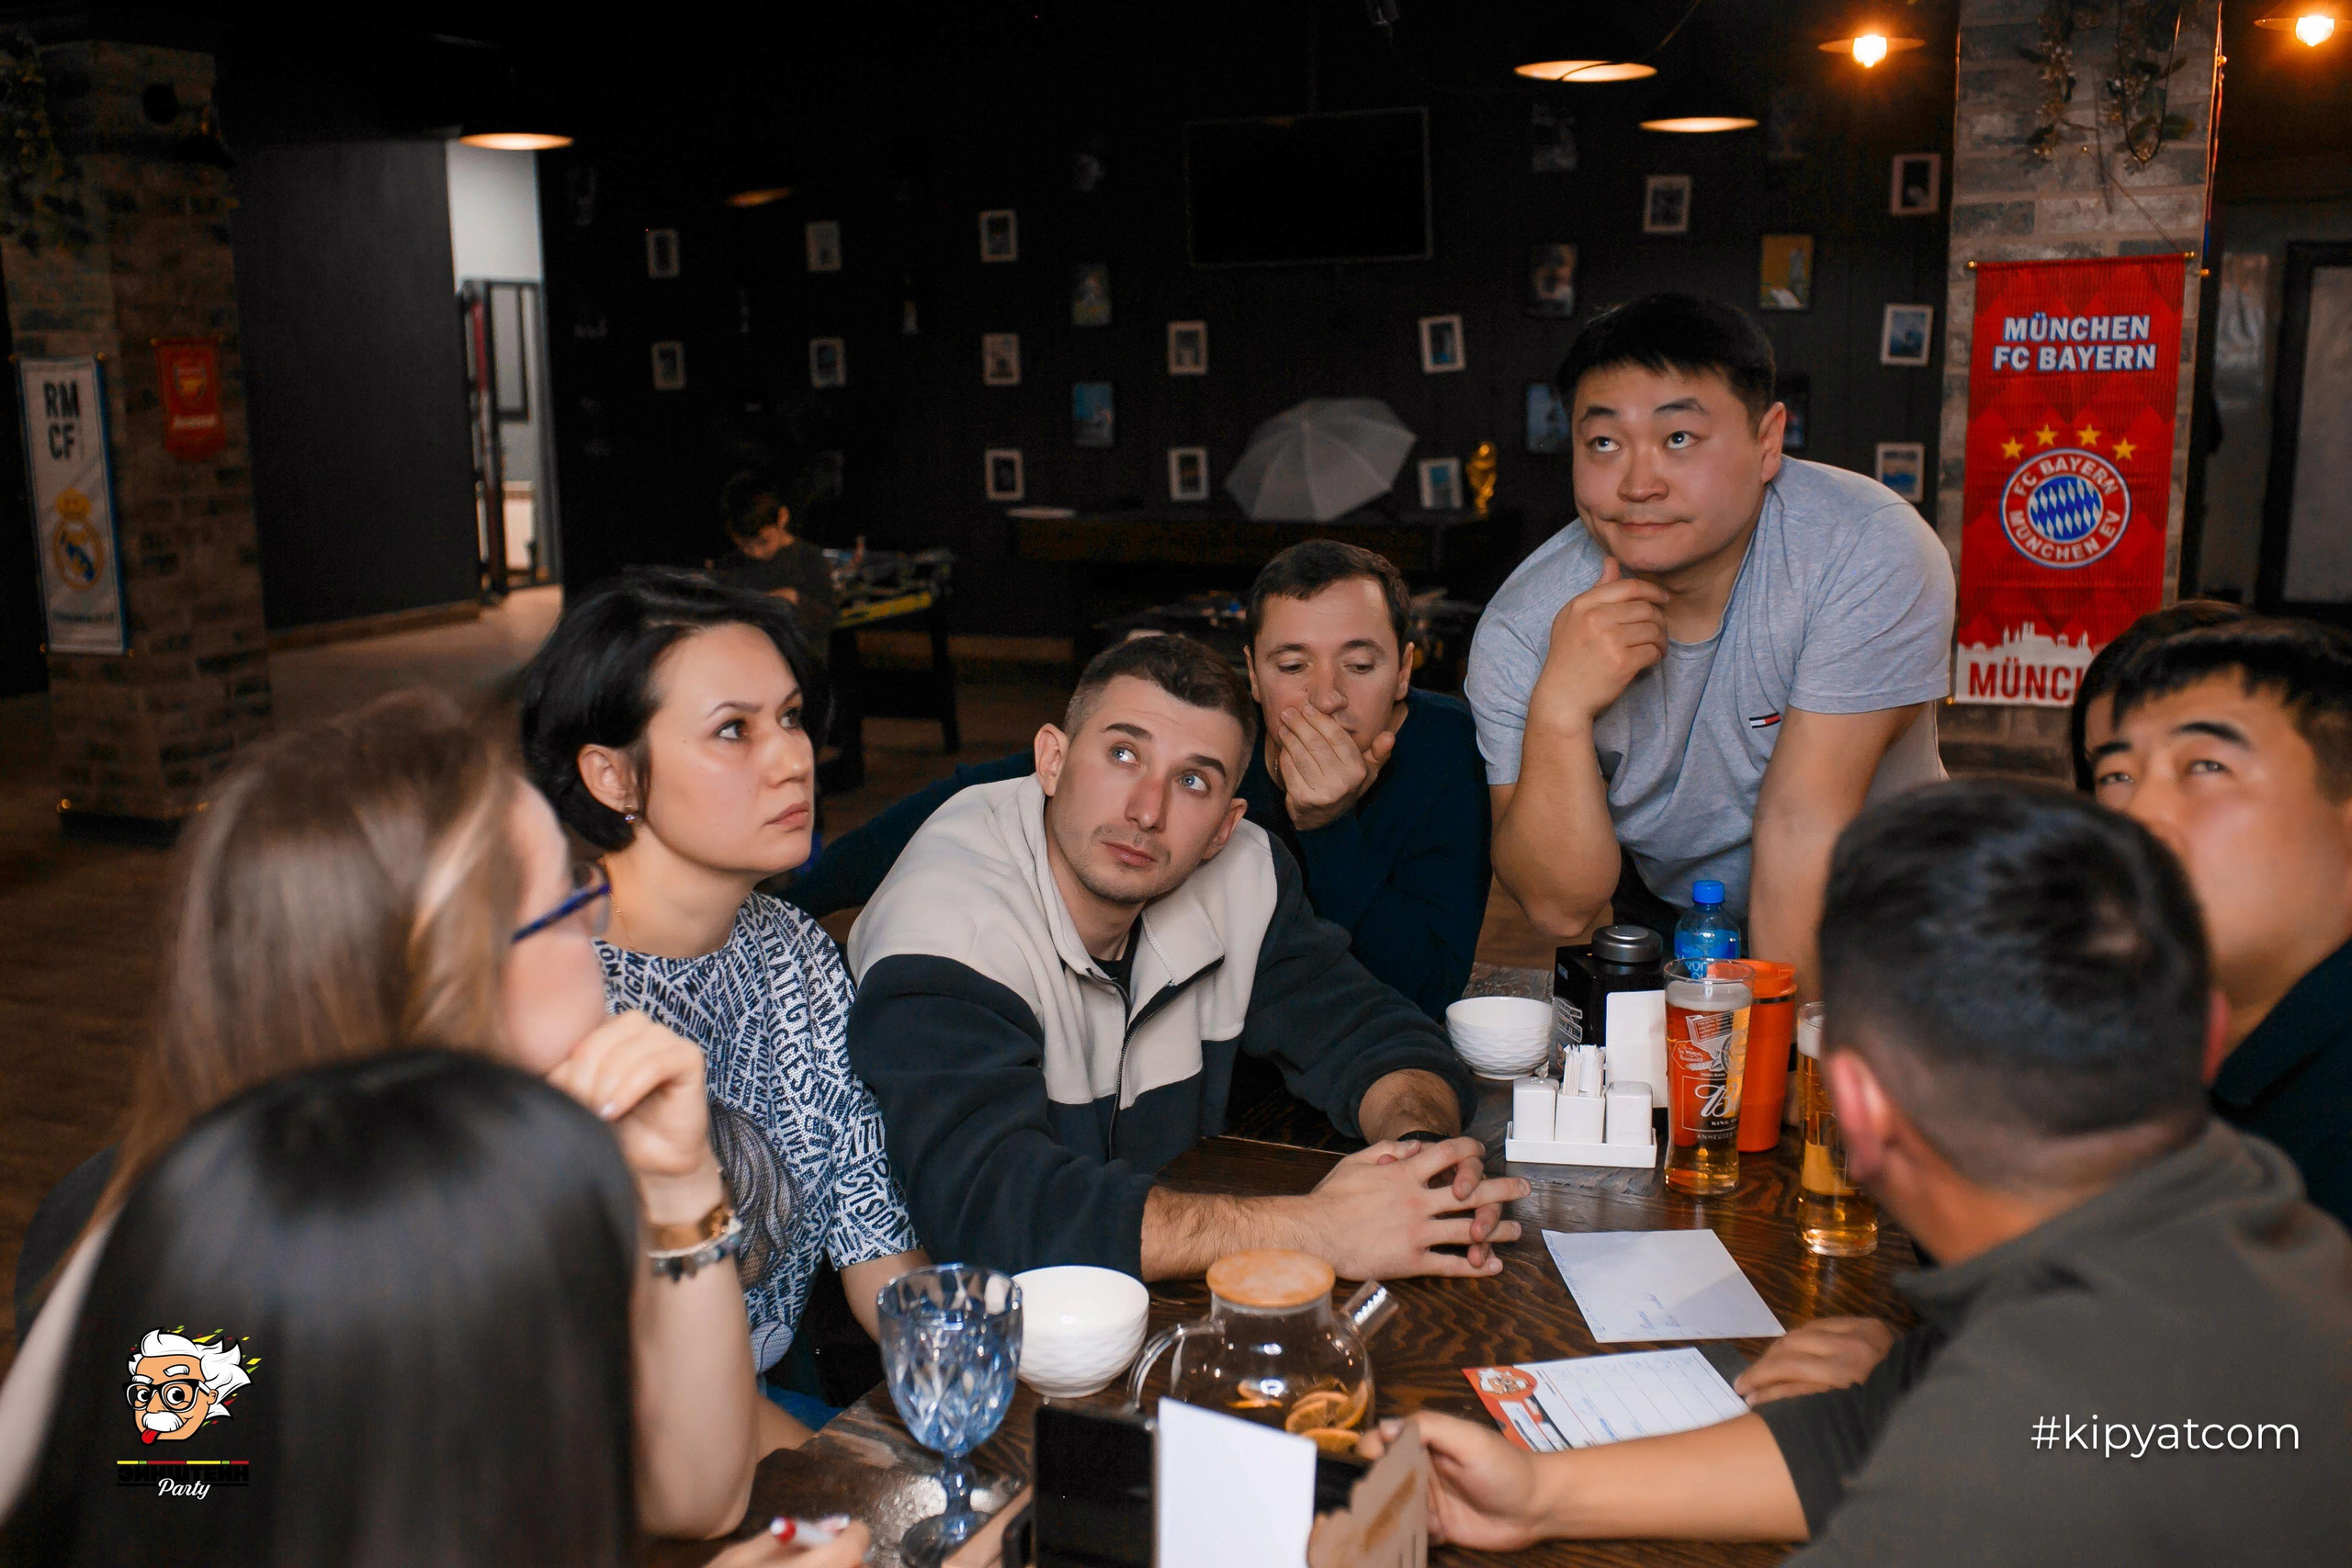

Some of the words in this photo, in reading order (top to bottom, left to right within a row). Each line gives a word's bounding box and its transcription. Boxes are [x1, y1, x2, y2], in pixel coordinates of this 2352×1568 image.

[2004, 311, 2150, 342] MÜNCHEN
[1993, 346, 2030, 371] FC
[2038, 344, 2156, 371] BAYERN
[43, 380, 80, 418] RM
[48, 423, 75, 459] CF
[2012, 471, 2037, 496] FC
[2040, 456, 2119, 494] BAYERN
[756, 914, 812, 1036] STRATEGY
[647, 975, 714, 1044] IMAGINATION
[728, 1014, 761, 1101] INSPIRATION
[763, 998, 819, 1105] SUCCESS
[770, 1075, 808, 1157] CREATIVE
